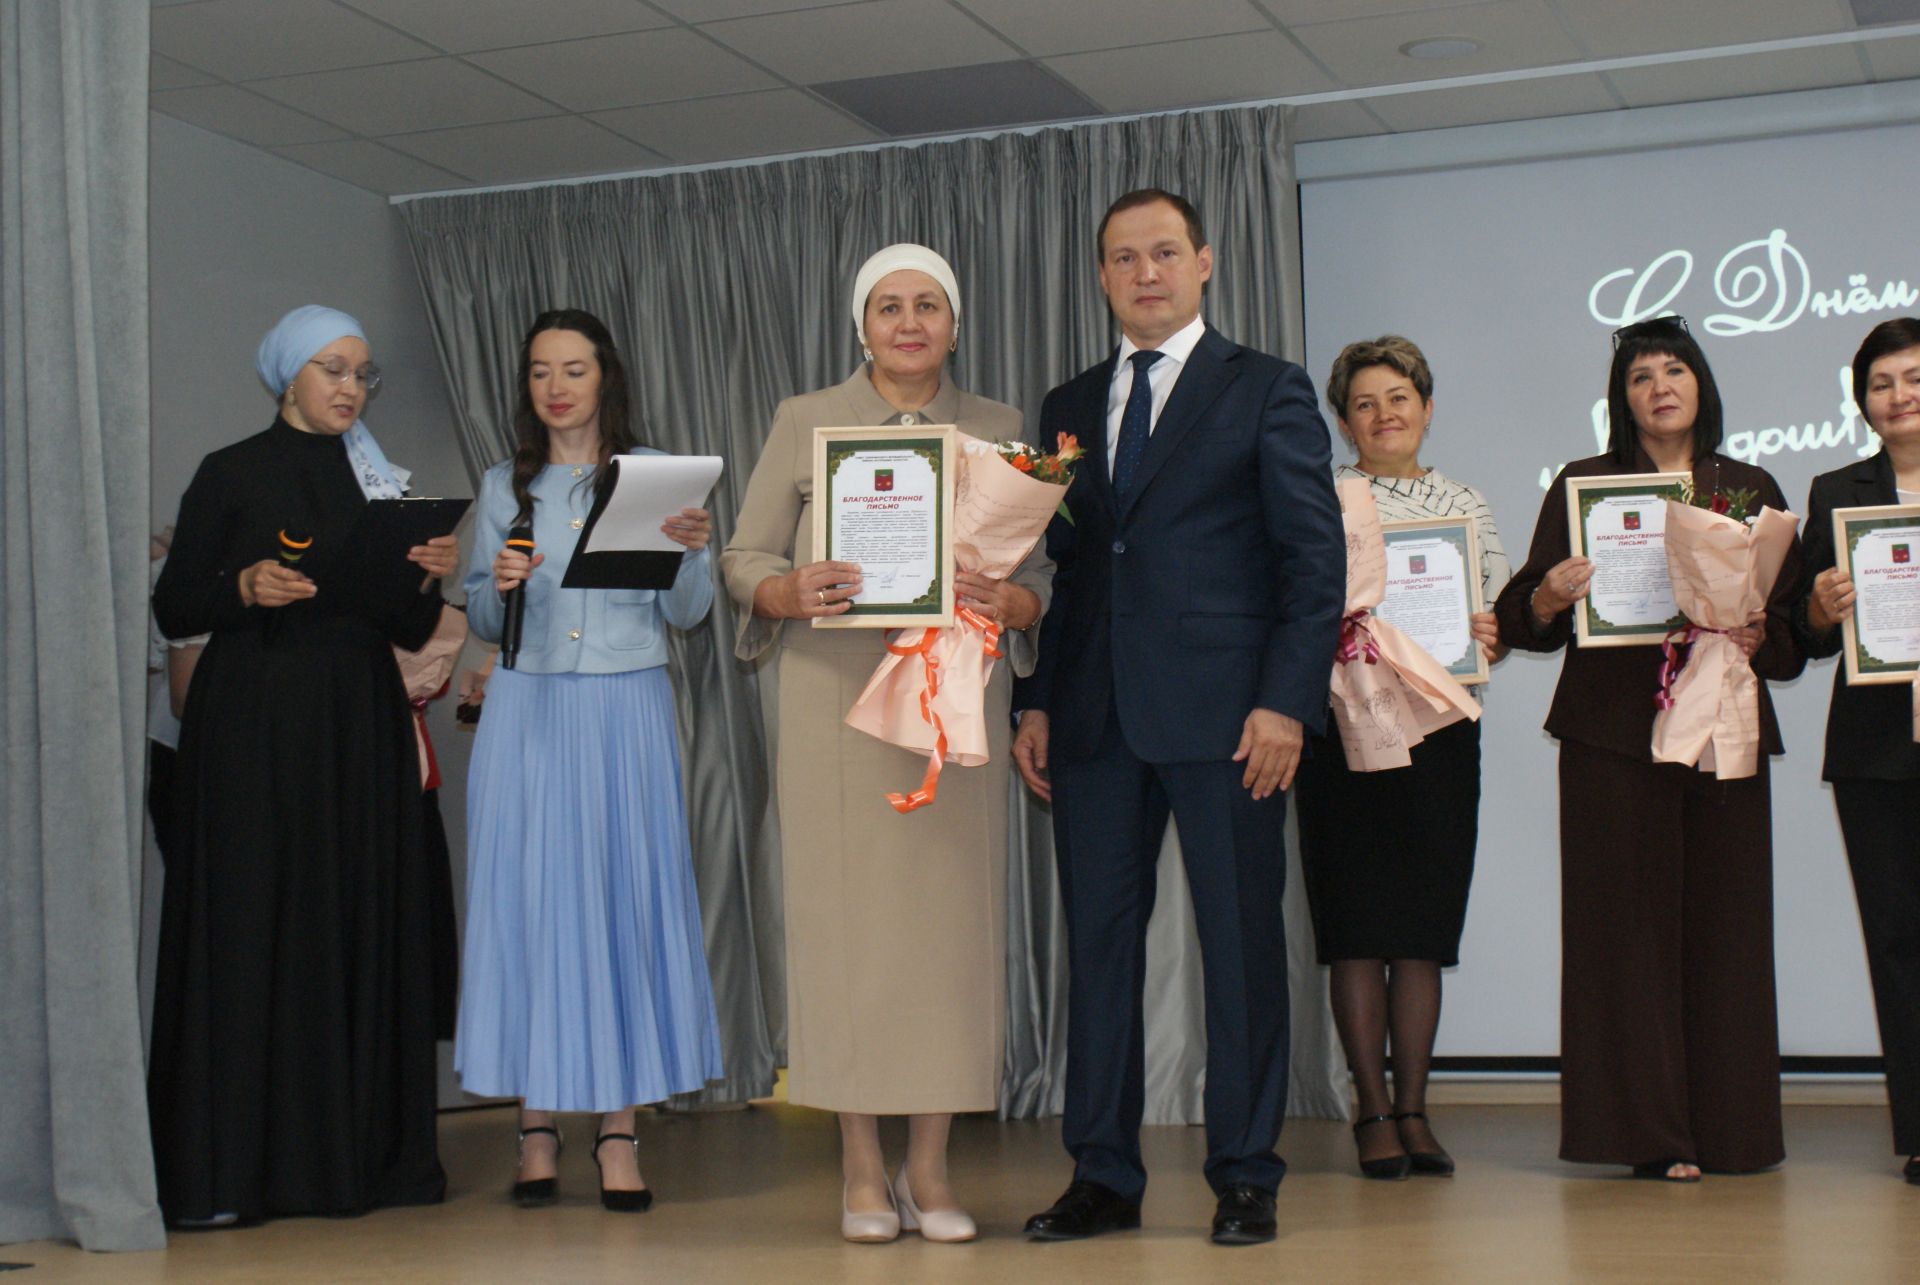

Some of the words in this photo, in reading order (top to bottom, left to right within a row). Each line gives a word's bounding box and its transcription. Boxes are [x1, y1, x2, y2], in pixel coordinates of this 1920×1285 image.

[1588, 249, 1693, 327] С
[1702, 228, 1919, 337] Днём
[843, 495, 924, 503] БЛАГОДАРСТВЕННОЕ
[1864, 566, 1920, 575] БЛАГОДАРСТВЕ
[1386, 576, 1453, 585] ЛАГОДАРСТВЕННОЕ
